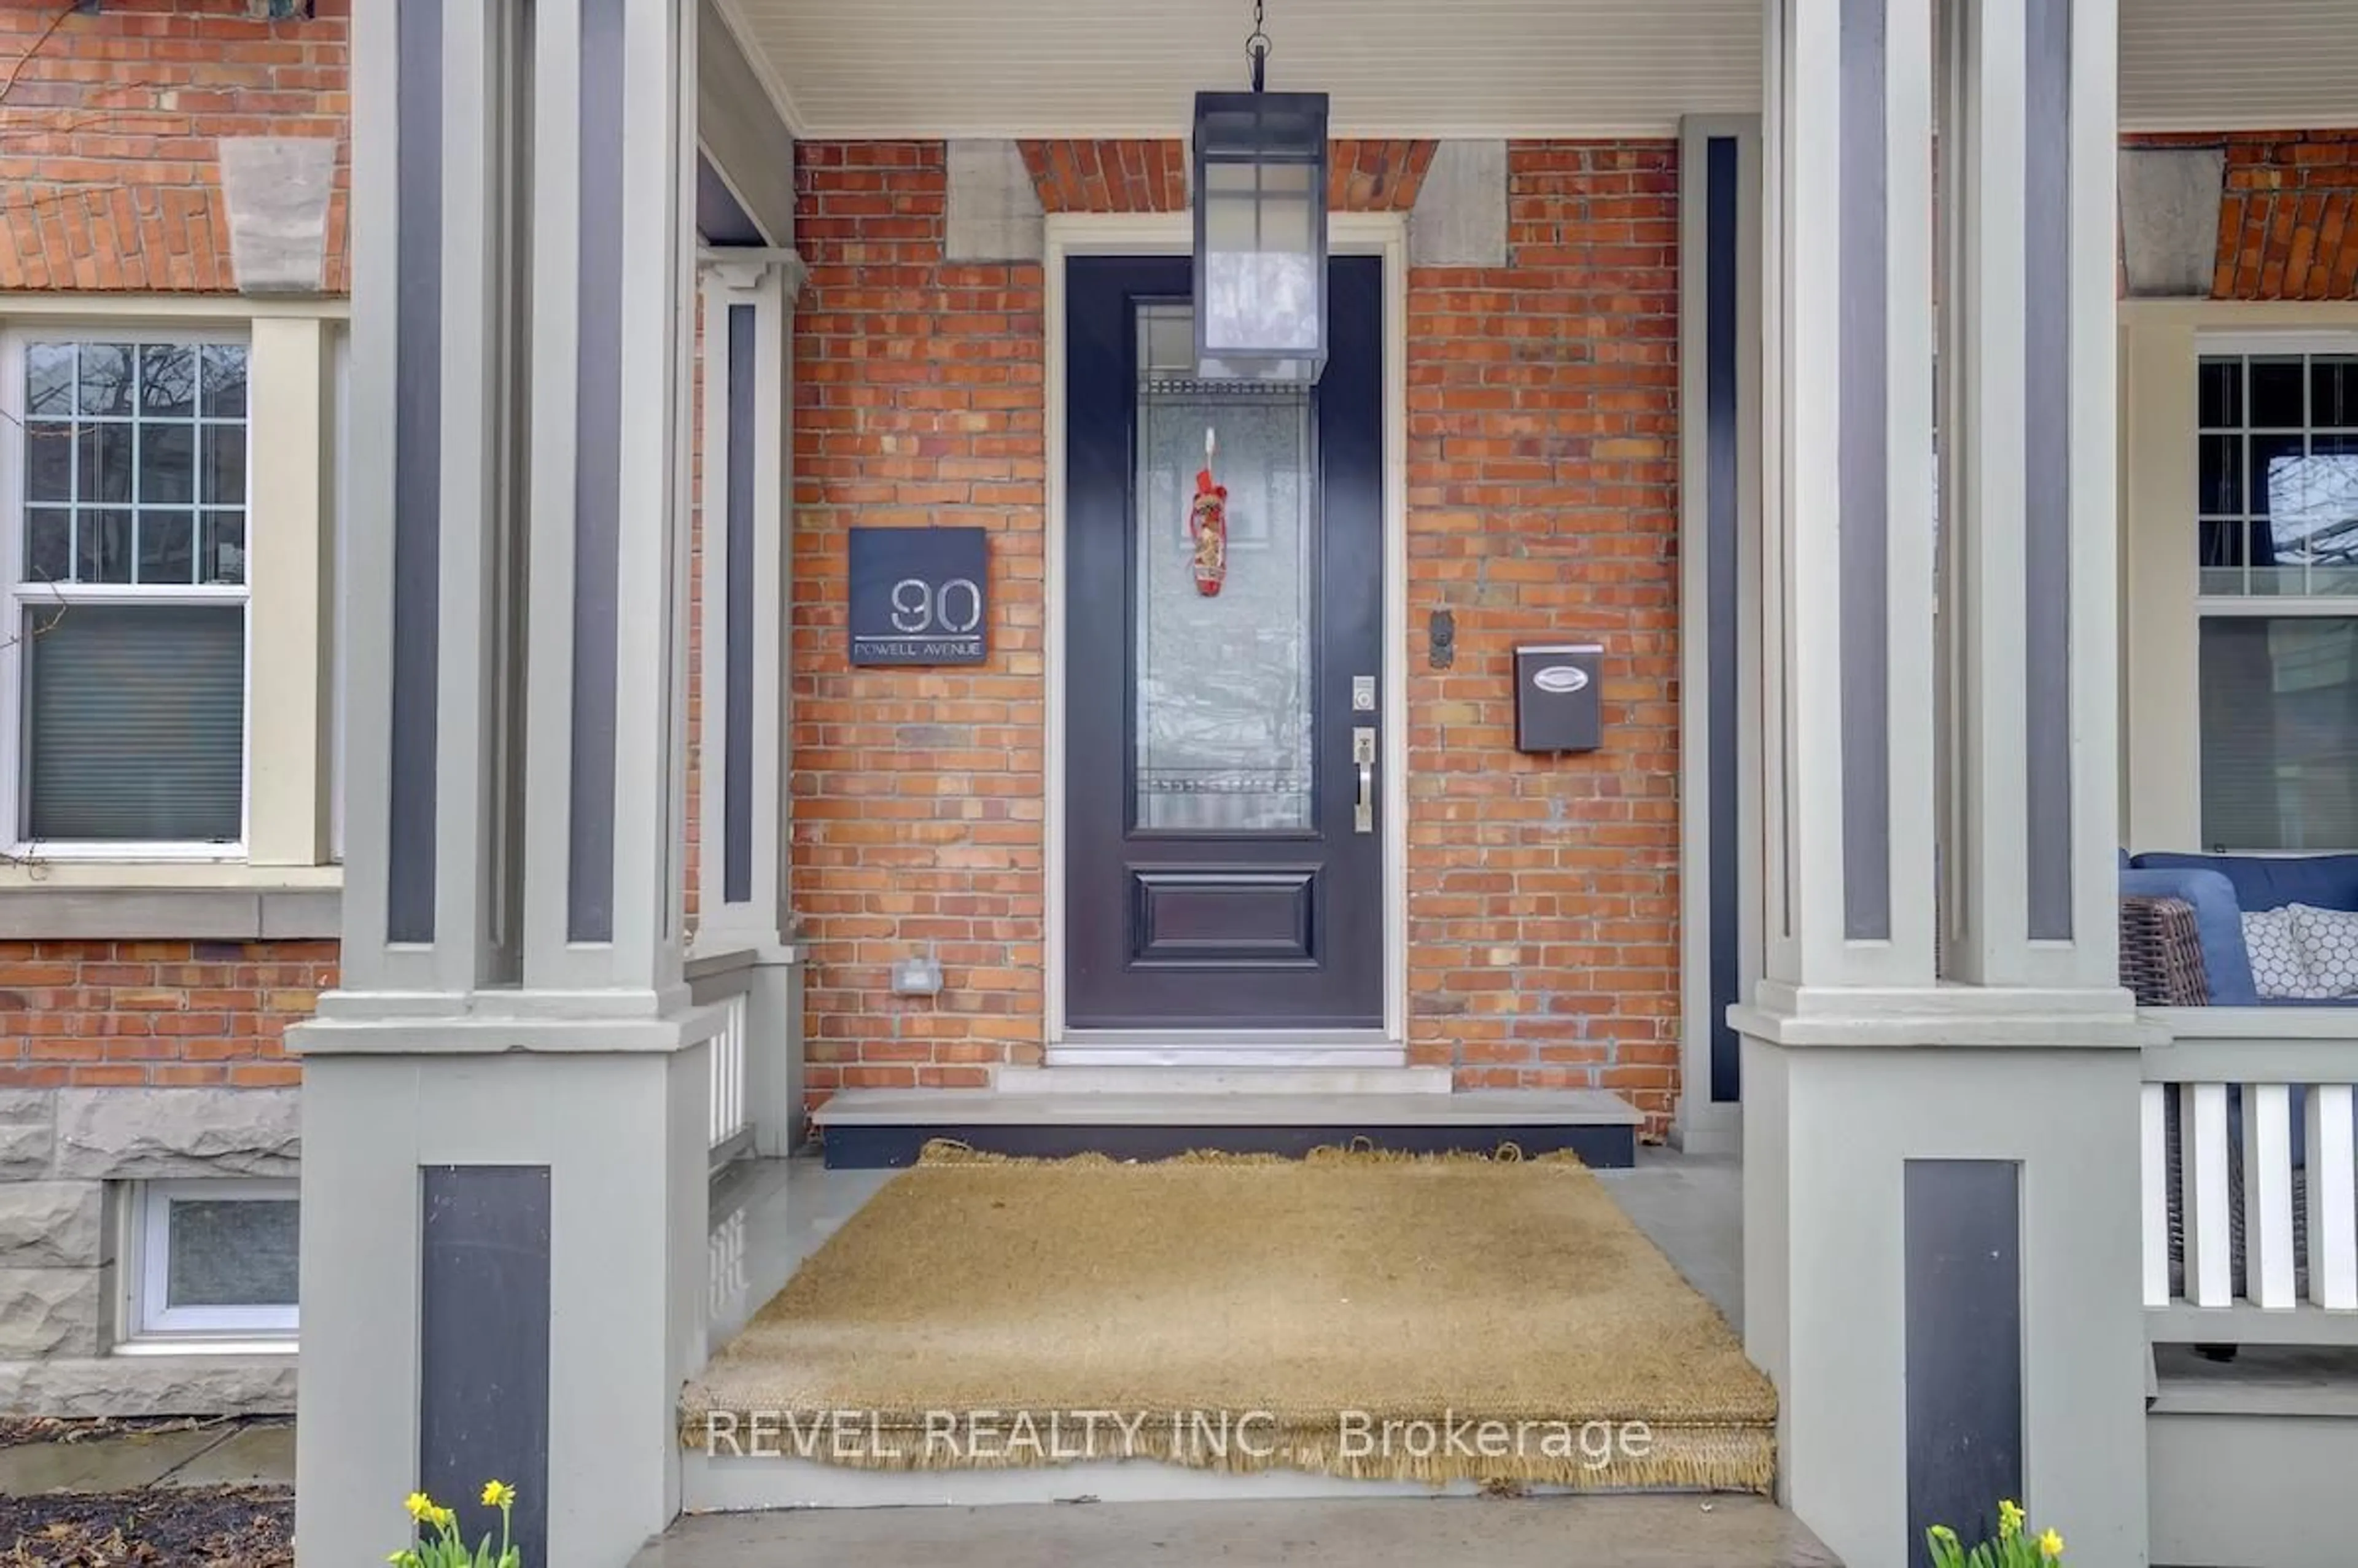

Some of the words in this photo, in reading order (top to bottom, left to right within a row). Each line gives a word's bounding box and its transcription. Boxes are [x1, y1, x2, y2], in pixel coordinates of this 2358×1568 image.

[892, 578, 981, 632] 90
[855, 644, 916, 655] POWELL
[924, 644, 981, 655] AVENUE
